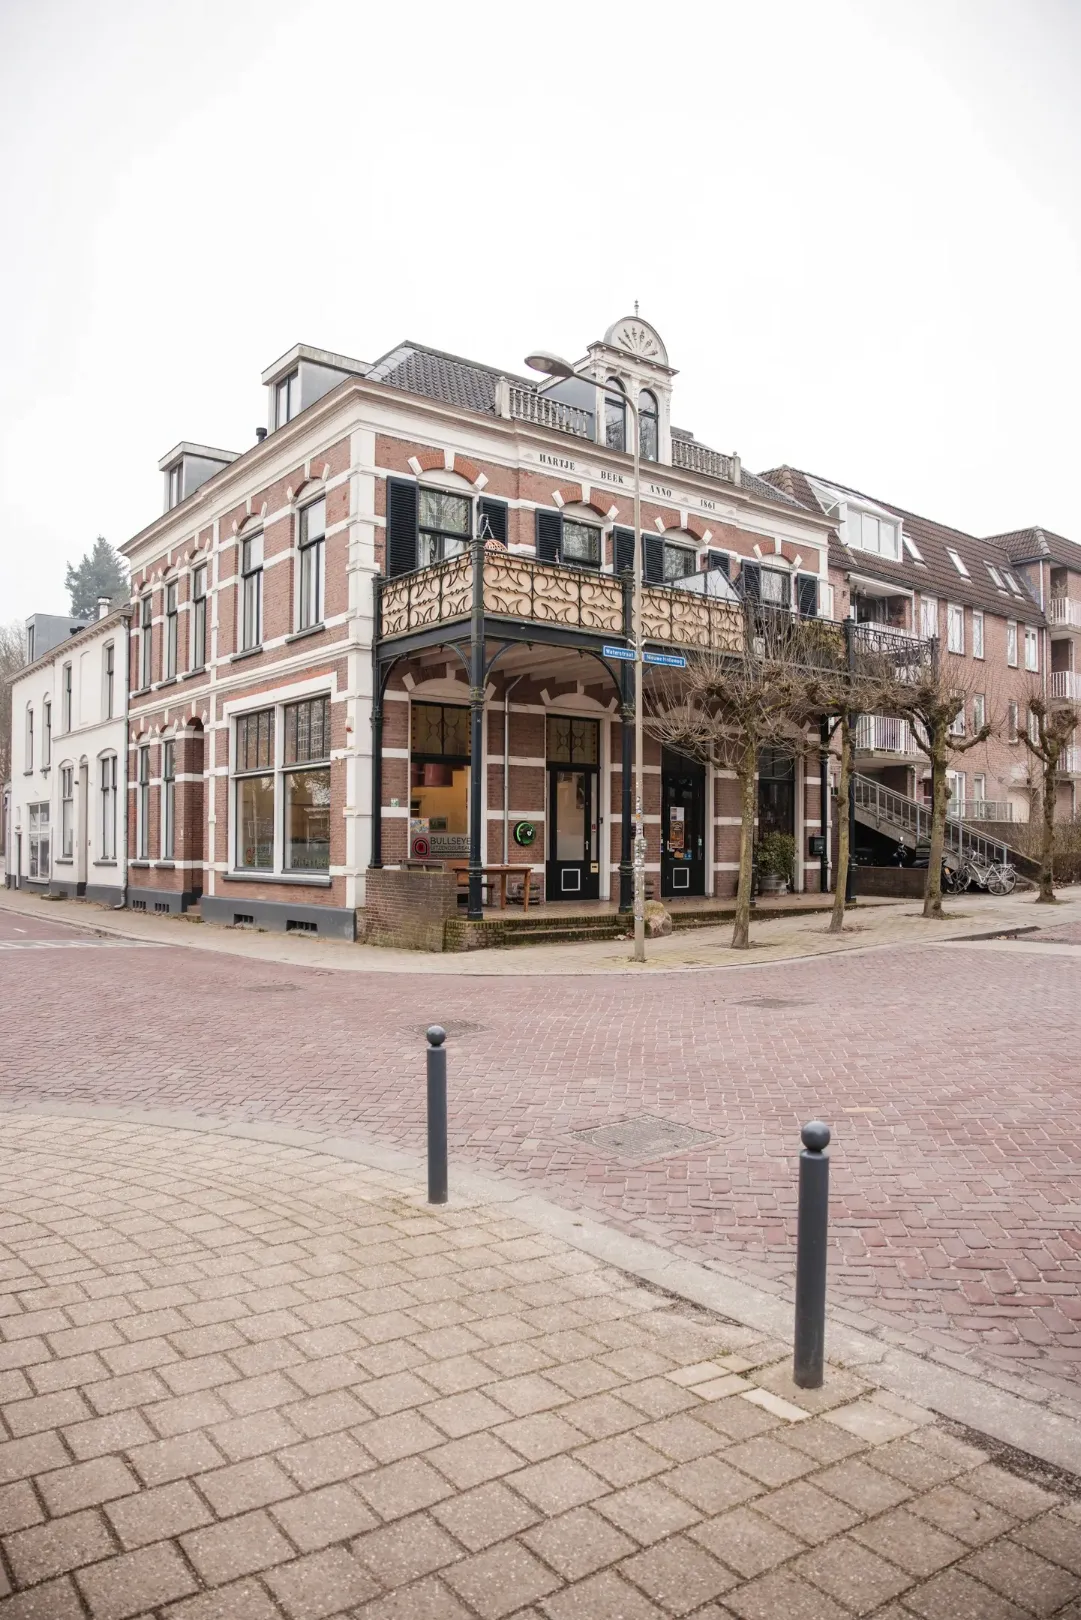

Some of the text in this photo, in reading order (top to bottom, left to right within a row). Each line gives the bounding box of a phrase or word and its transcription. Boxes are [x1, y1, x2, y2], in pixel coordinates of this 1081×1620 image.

[539, 453, 716, 510] HARTJE BEEK ANNO 1861
[605, 648, 634, 658] Waterstraat
[430, 837, 471, 845] BULLSEYE
